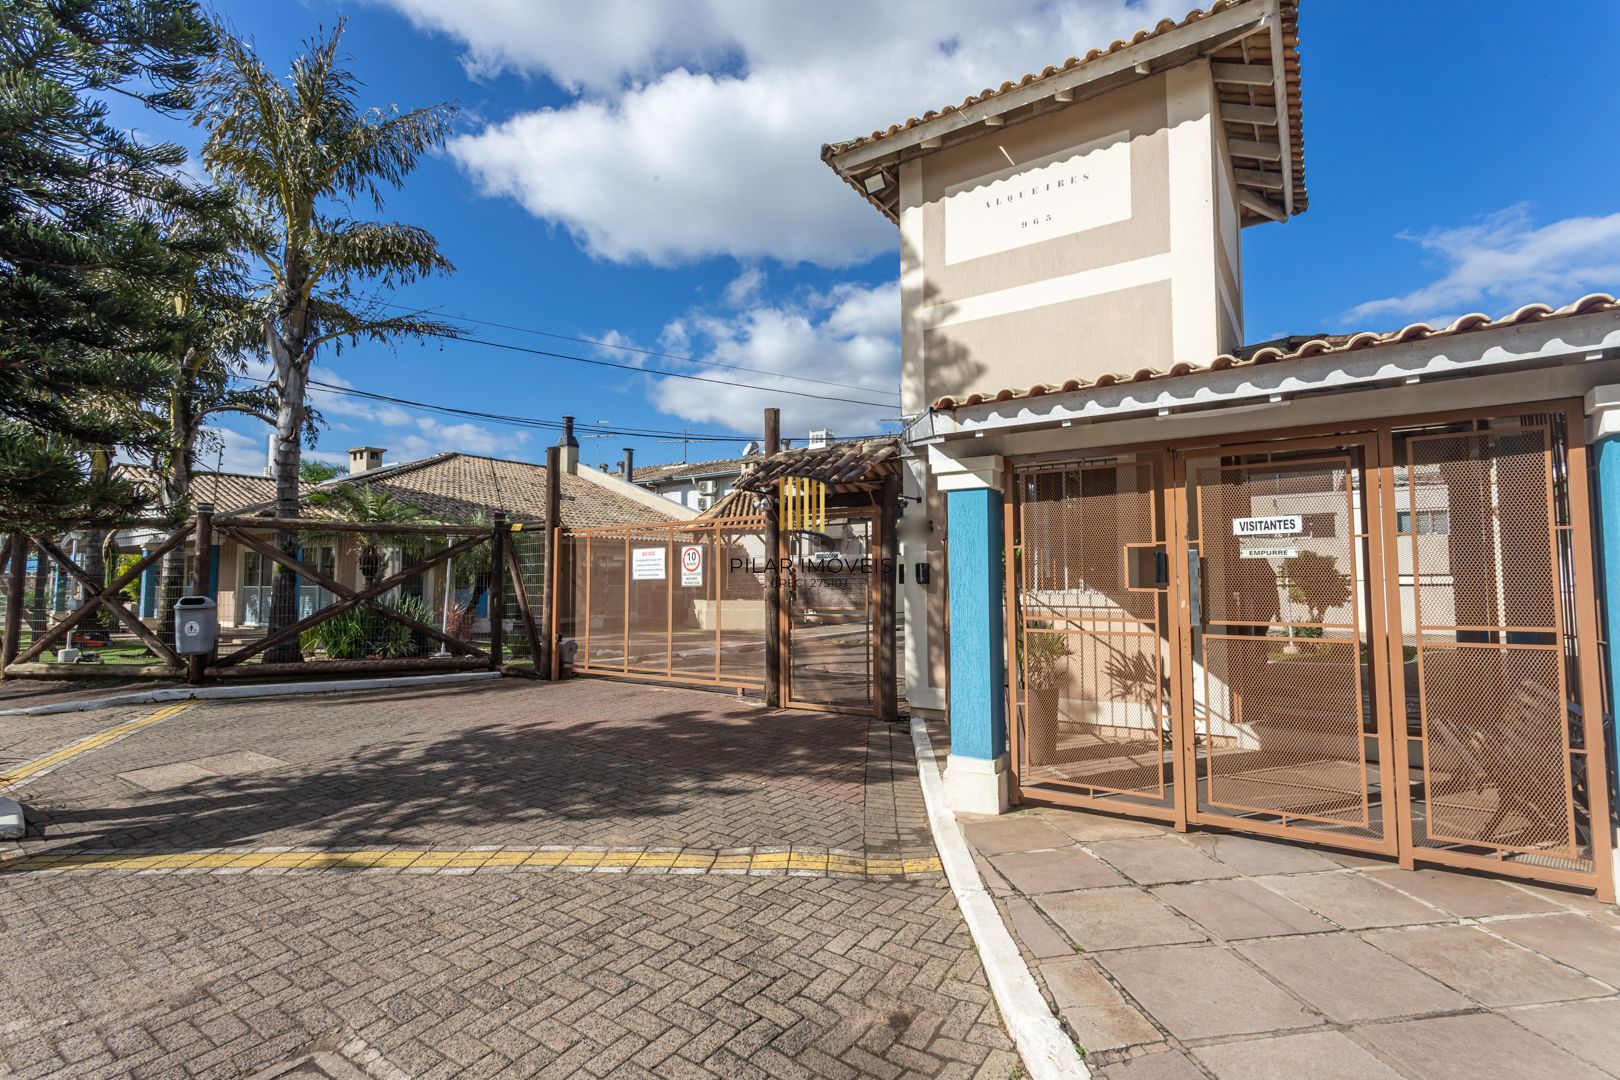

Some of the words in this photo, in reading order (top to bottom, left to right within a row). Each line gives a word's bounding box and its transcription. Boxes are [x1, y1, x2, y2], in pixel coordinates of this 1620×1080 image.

[984, 172, 1090, 208] ALQUEIRES
[1021, 214, 1052, 228] 965
[1239, 519, 1296, 532] VISITANTES
[687, 552, 696, 561] 10
